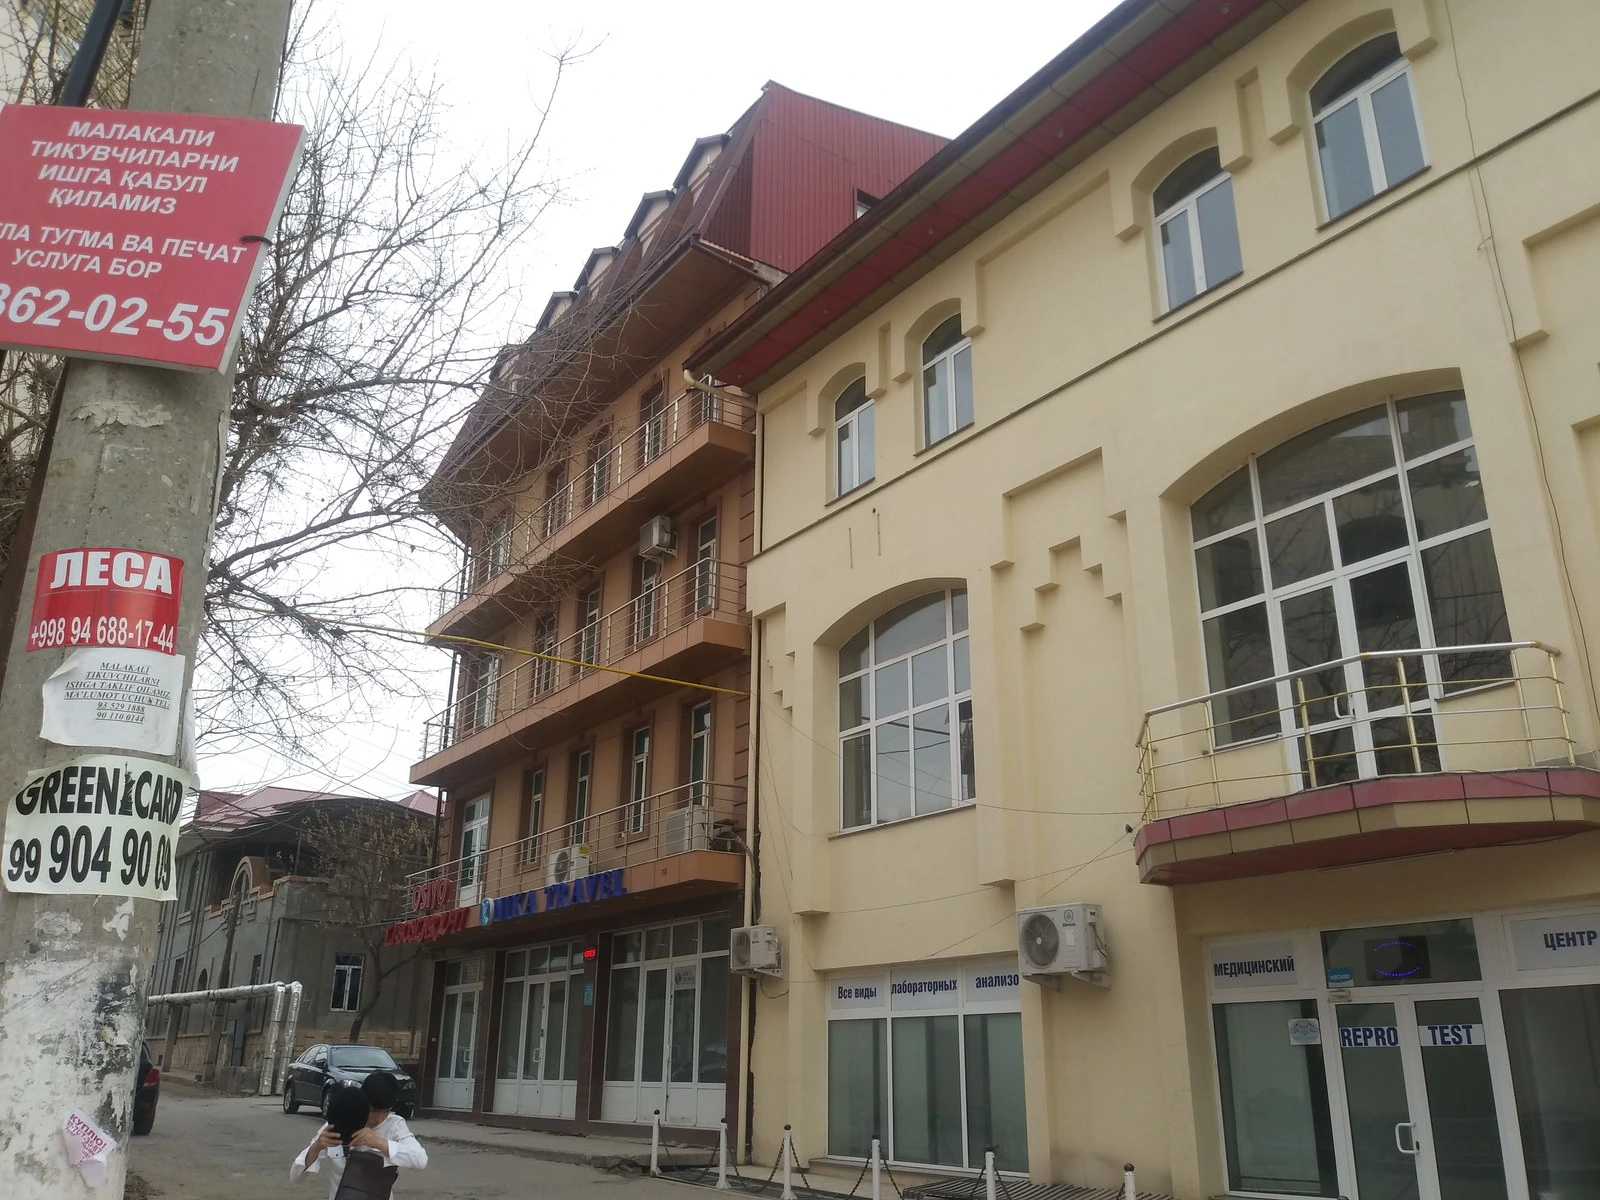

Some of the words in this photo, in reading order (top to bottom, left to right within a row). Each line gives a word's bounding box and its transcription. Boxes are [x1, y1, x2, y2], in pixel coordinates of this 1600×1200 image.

[68, 121, 215, 147] МАЛАКАЛИ
[31, 140, 239, 173] ТИКУВЧИЛАРНИ
[38, 164, 111, 185] ИШГА
[120, 170, 208, 193] ҚАБУЛ
[48, 188, 177, 215] ҚИЛАМИЗ
[0, 222, 30, 242] ЛА
[40, 226, 114, 250] ТУГМА
[121, 234, 154, 254] ВА
[161, 238, 247, 264] ПЕЧАТ
[11, 248, 101, 274] УСЛУГА
[108, 259, 163, 279] БОР
[50, 551, 173, 595] ЛЕСА
[31, 617, 66, 648] +998
[70, 616, 91, 644] 94
[96, 616, 174, 654] 688-17-44
[86, 671, 160, 686] TIKUVCHILARNI
[100, 662, 150, 674] MALAKALI
[65, 681, 97, 690] ISHGA
[100, 682, 136, 691] TAKLIF
[97, 702, 107, 710] 93
[110, 702, 124, 710] 529
[109, 712, 123, 720] 110
[15, 766, 121, 816] GREEN
[134, 770, 183, 826] CARD
[7, 838, 42, 883] 99
[48, 824, 112, 884] 904
[120, 828, 152, 887] 90
[544, 868, 627, 910] TRAVEL
[1214, 955, 1295, 977] МЕДИЦИНСКИЙ
[1543, 930, 1598, 951] ЦЕНТР
[838, 986, 852, 999] Все
[855, 986, 877, 1000] виды
[891, 979, 957, 996] лабораторных
[1340, 1026, 1399, 1047] REPRO
[1428, 1024, 1472, 1045] TEST
[70, 1114, 107, 1149] КУПЛЮ!
